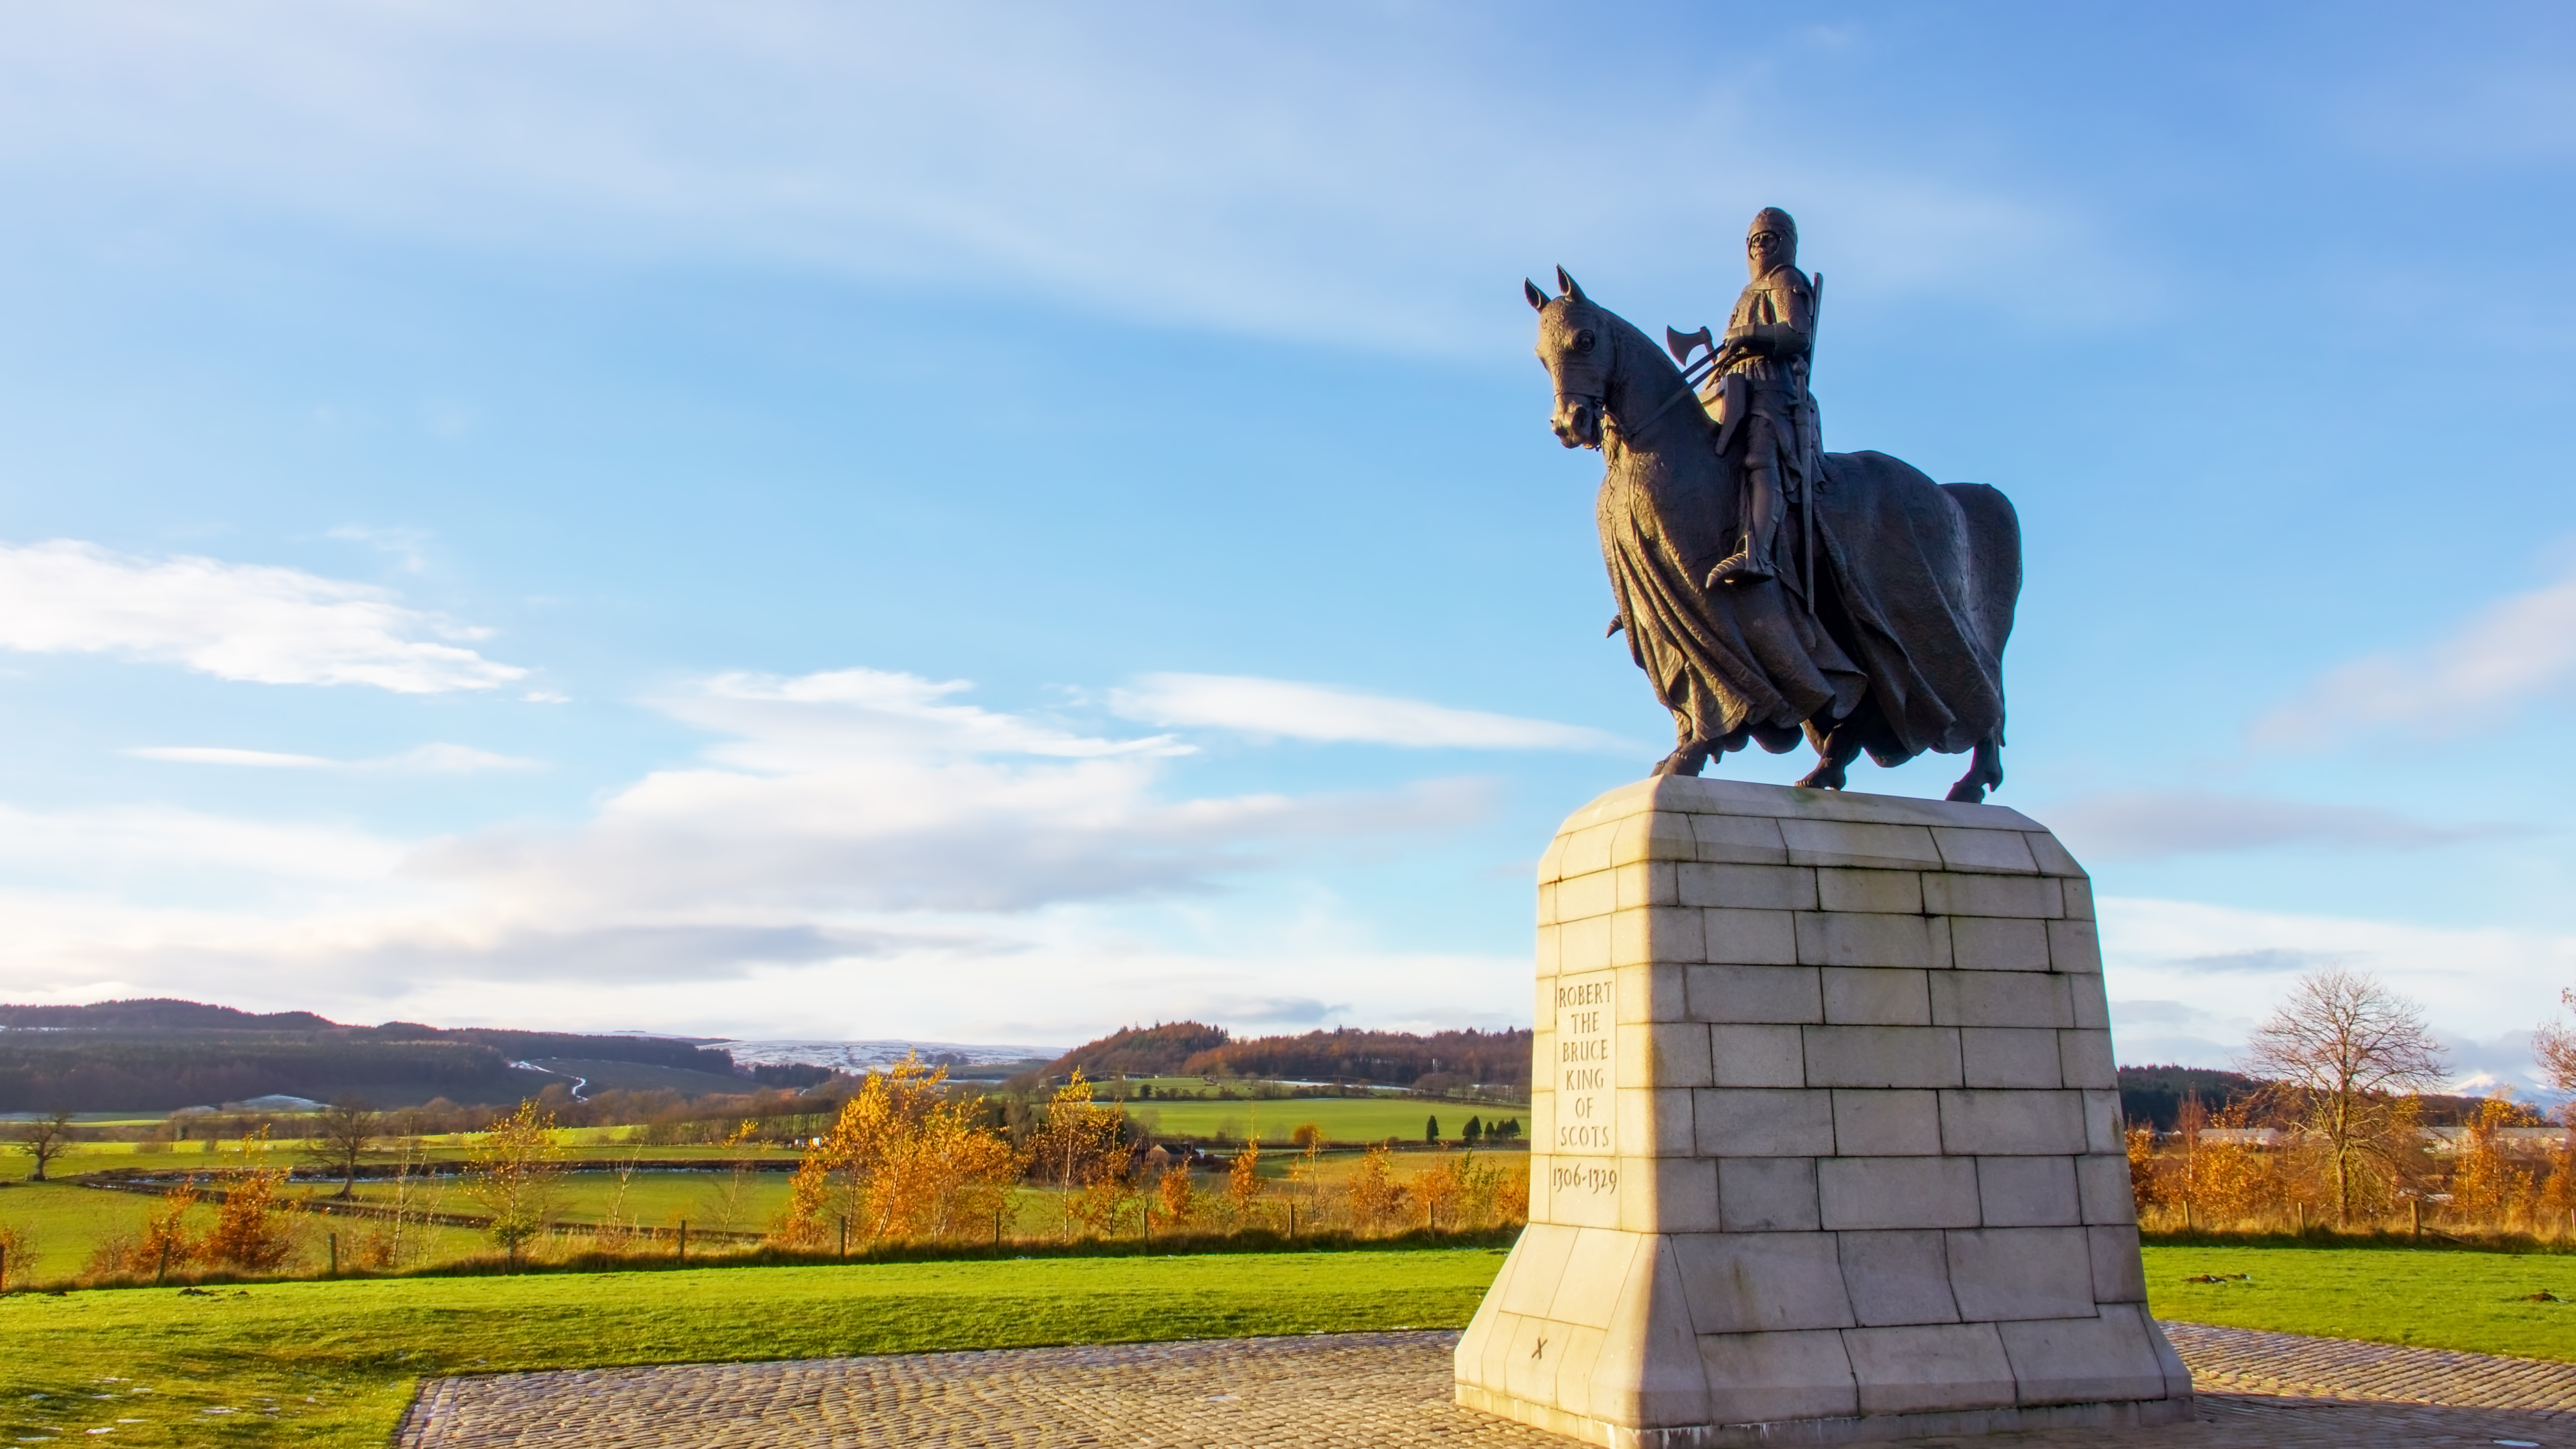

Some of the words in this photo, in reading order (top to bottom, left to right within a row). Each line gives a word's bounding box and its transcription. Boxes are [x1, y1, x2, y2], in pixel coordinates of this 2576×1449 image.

[1559, 981, 1613, 1008] ROBERT
[1571, 1011, 1599, 1034] THE
[1563, 1039, 1608, 1063] BRUCE
[1567, 1068, 1603, 1090] KING
[1576, 1097, 1594, 1119] OF
[1561, 1126, 1609, 1147] SCOTS
[1554, 1163, 1617, 1195] 1306-1329
